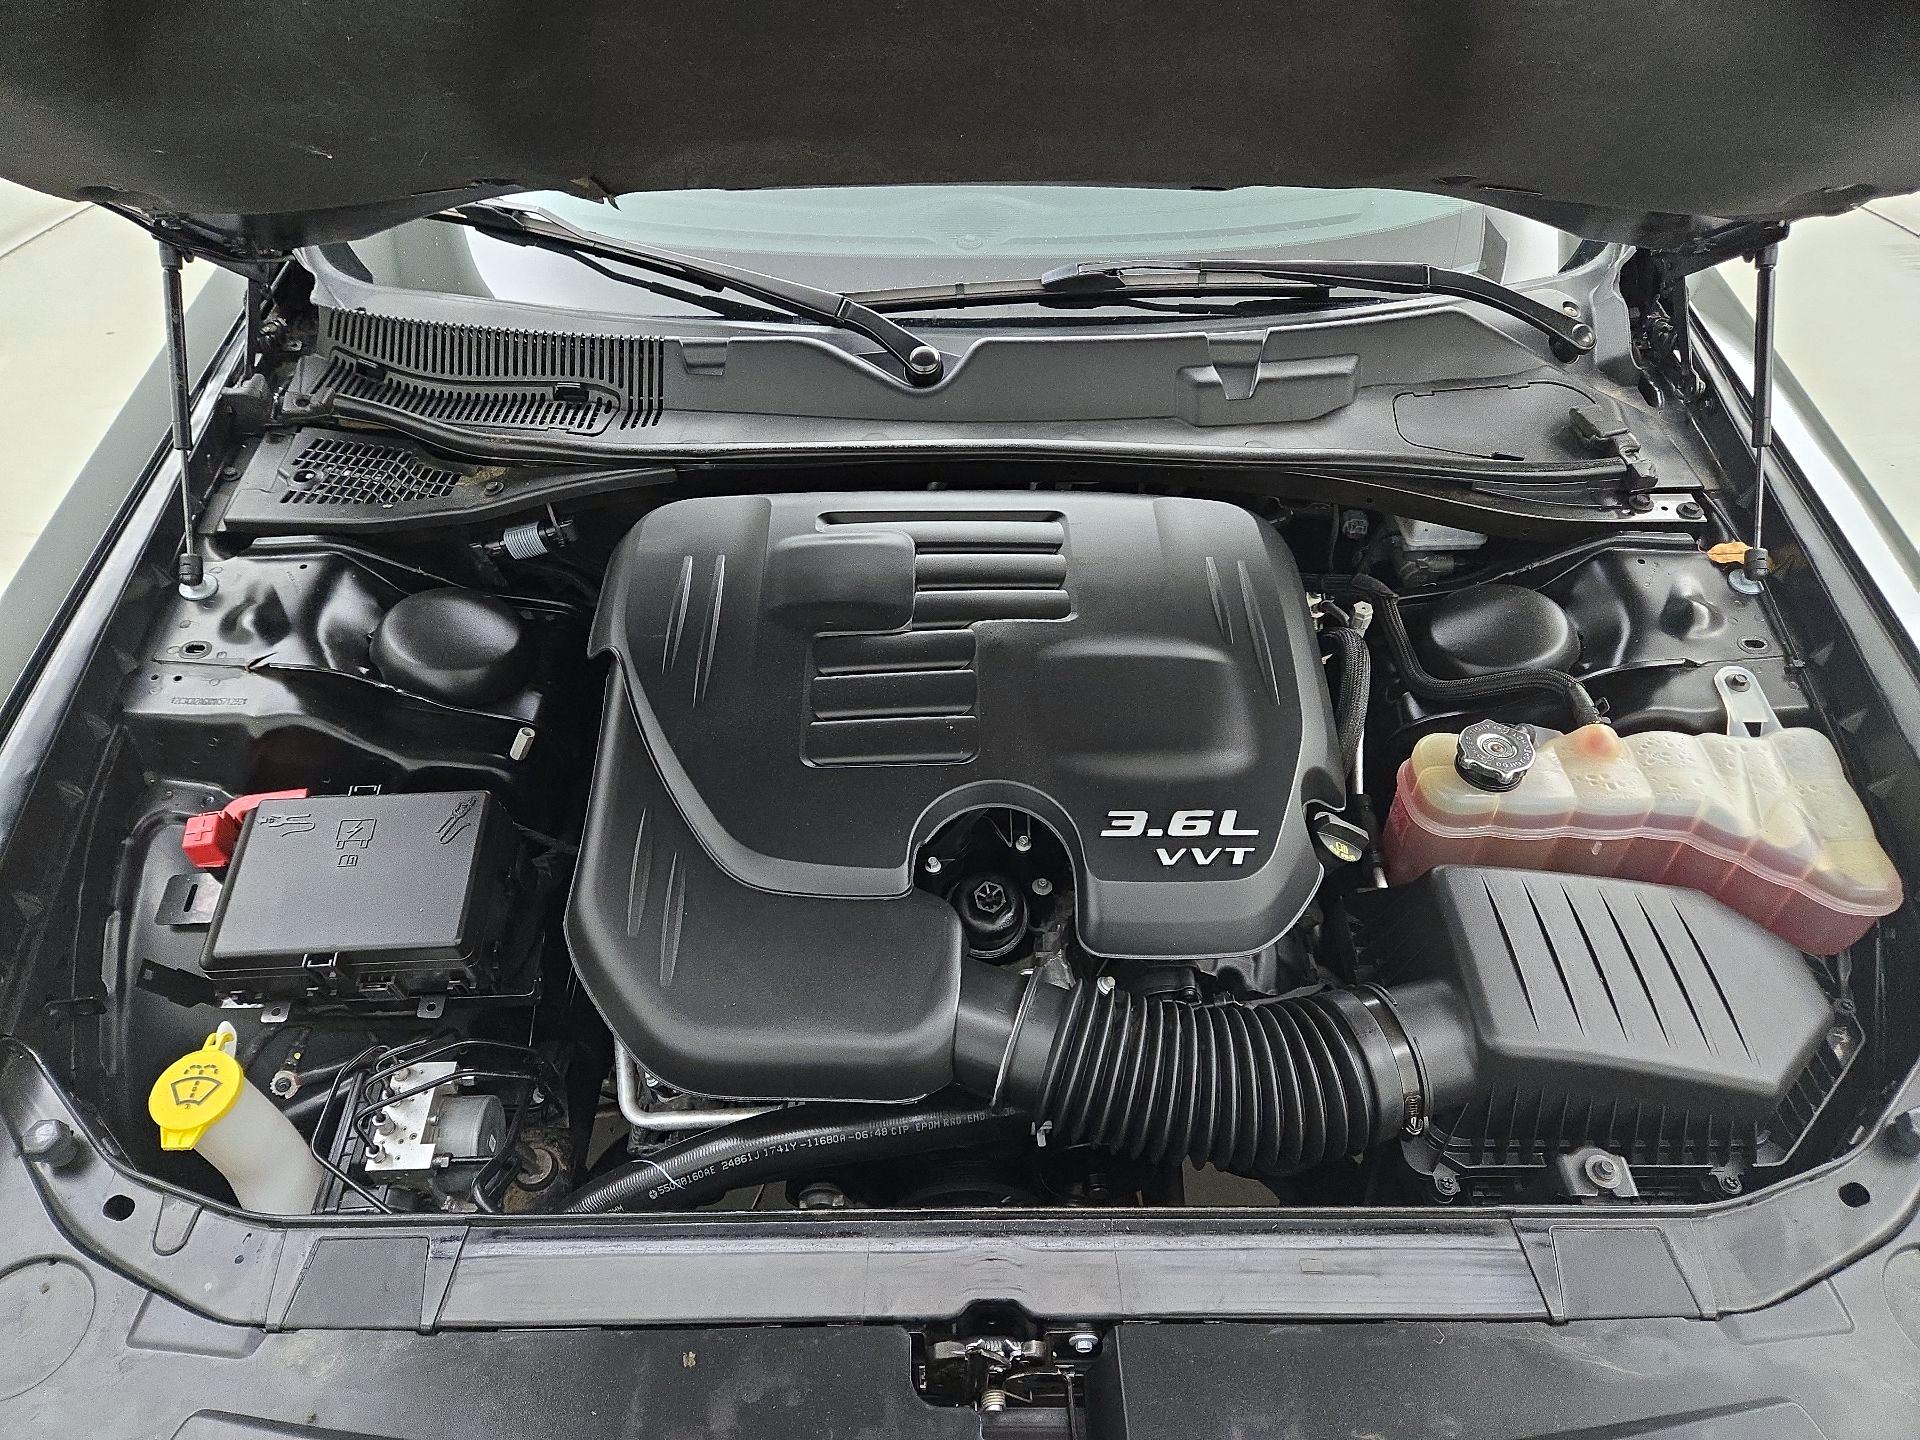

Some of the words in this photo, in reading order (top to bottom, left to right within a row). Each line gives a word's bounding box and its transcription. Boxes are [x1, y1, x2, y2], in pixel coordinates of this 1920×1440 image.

[1100, 809, 1260, 838] 3.6L
[1154, 847, 1257, 866] VVT
[915, 1120, 941, 1133] EPDM
